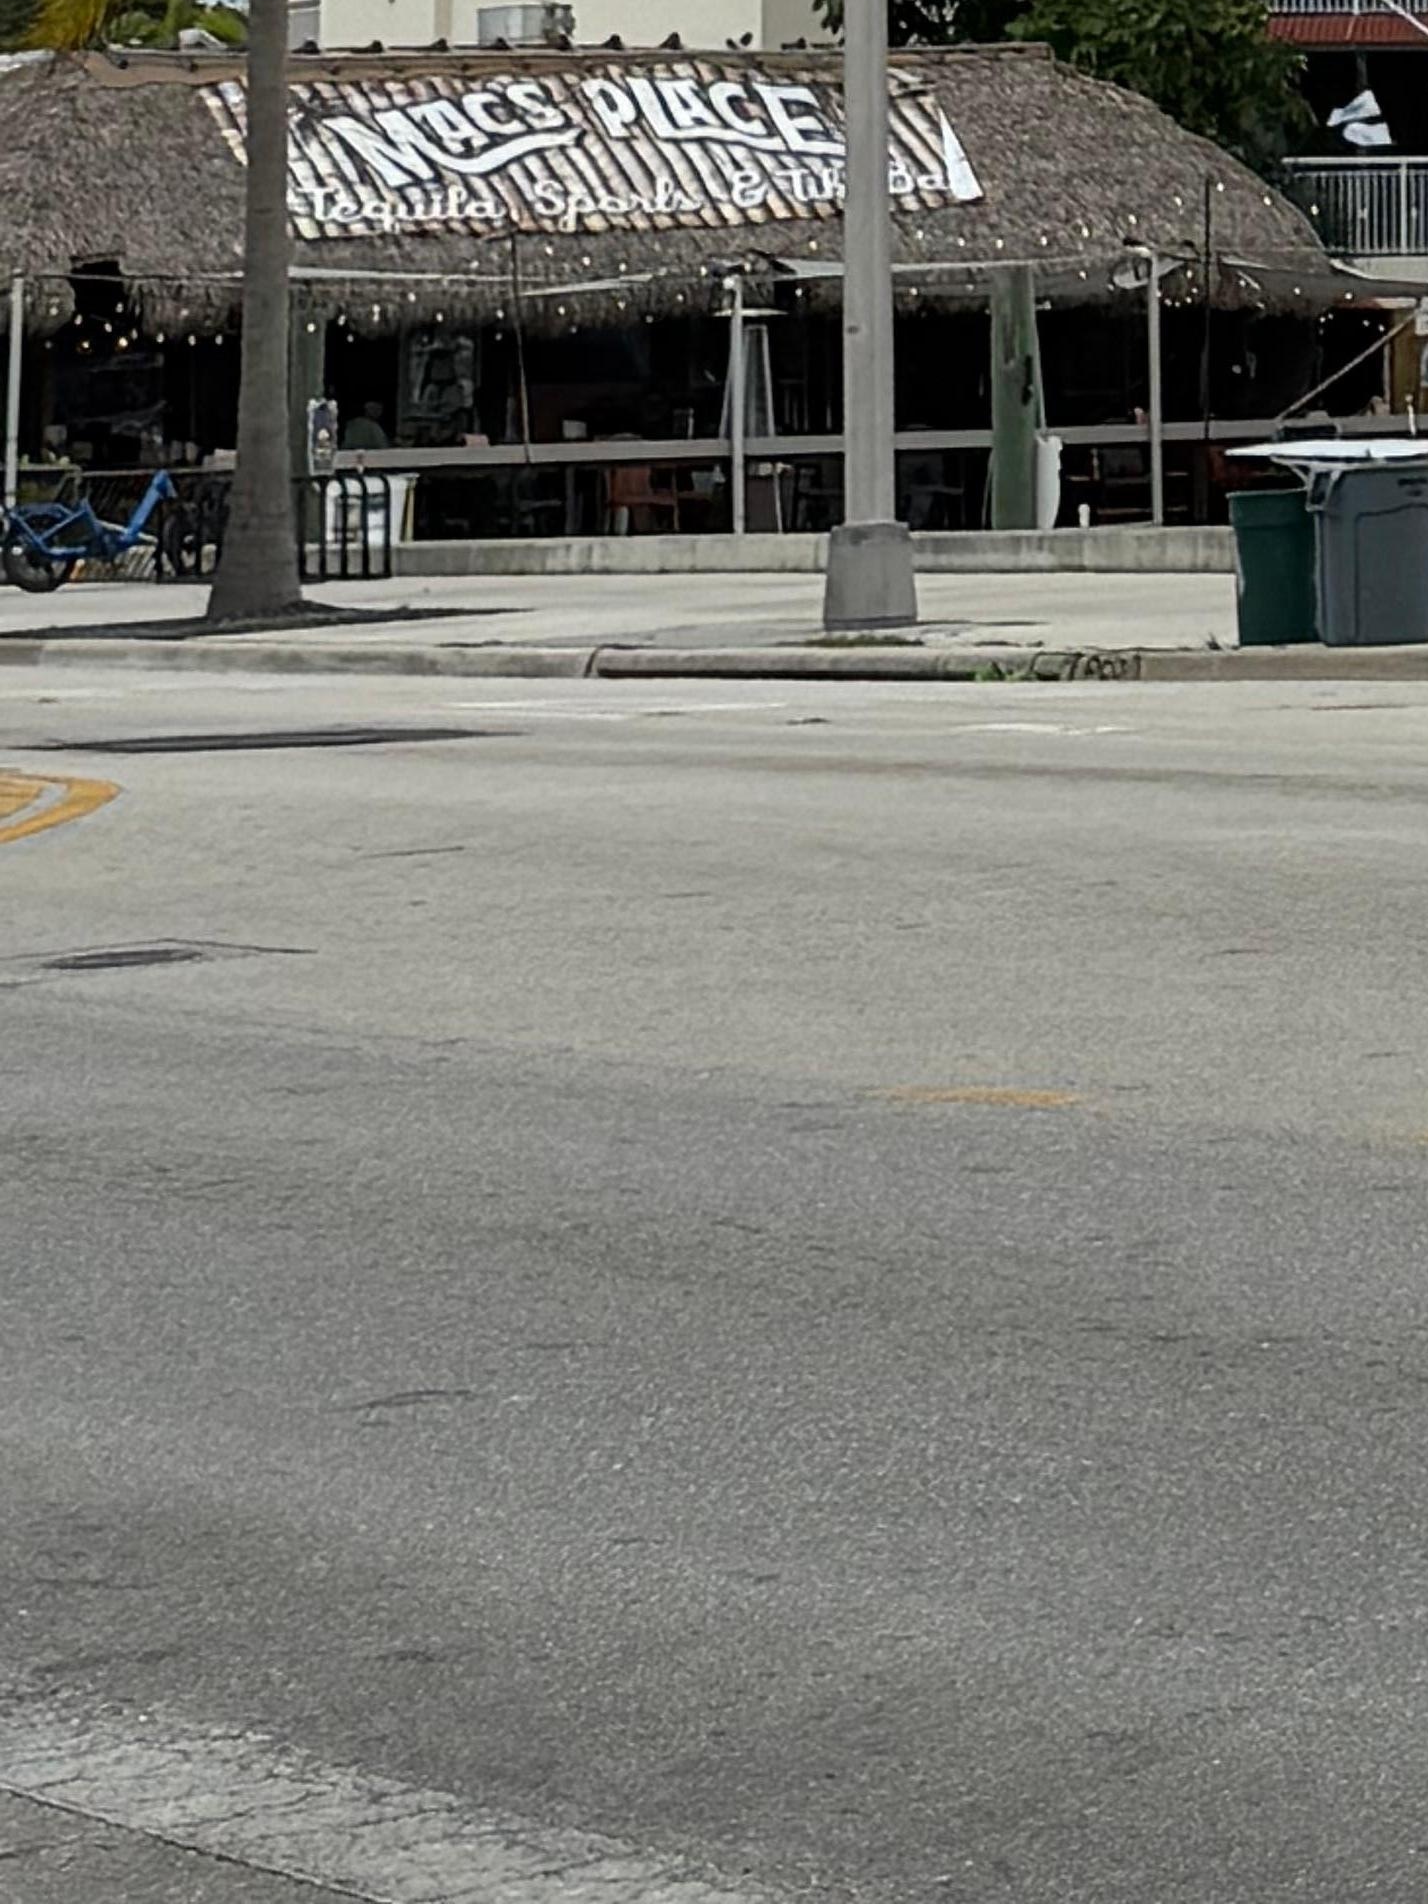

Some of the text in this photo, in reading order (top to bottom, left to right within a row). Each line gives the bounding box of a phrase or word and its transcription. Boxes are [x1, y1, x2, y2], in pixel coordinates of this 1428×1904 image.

[580, 75, 845, 155] PLACE
[297, 183, 508, 234] Tequila
[532, 180, 703, 233] Sports
[730, 168, 769, 208] &
